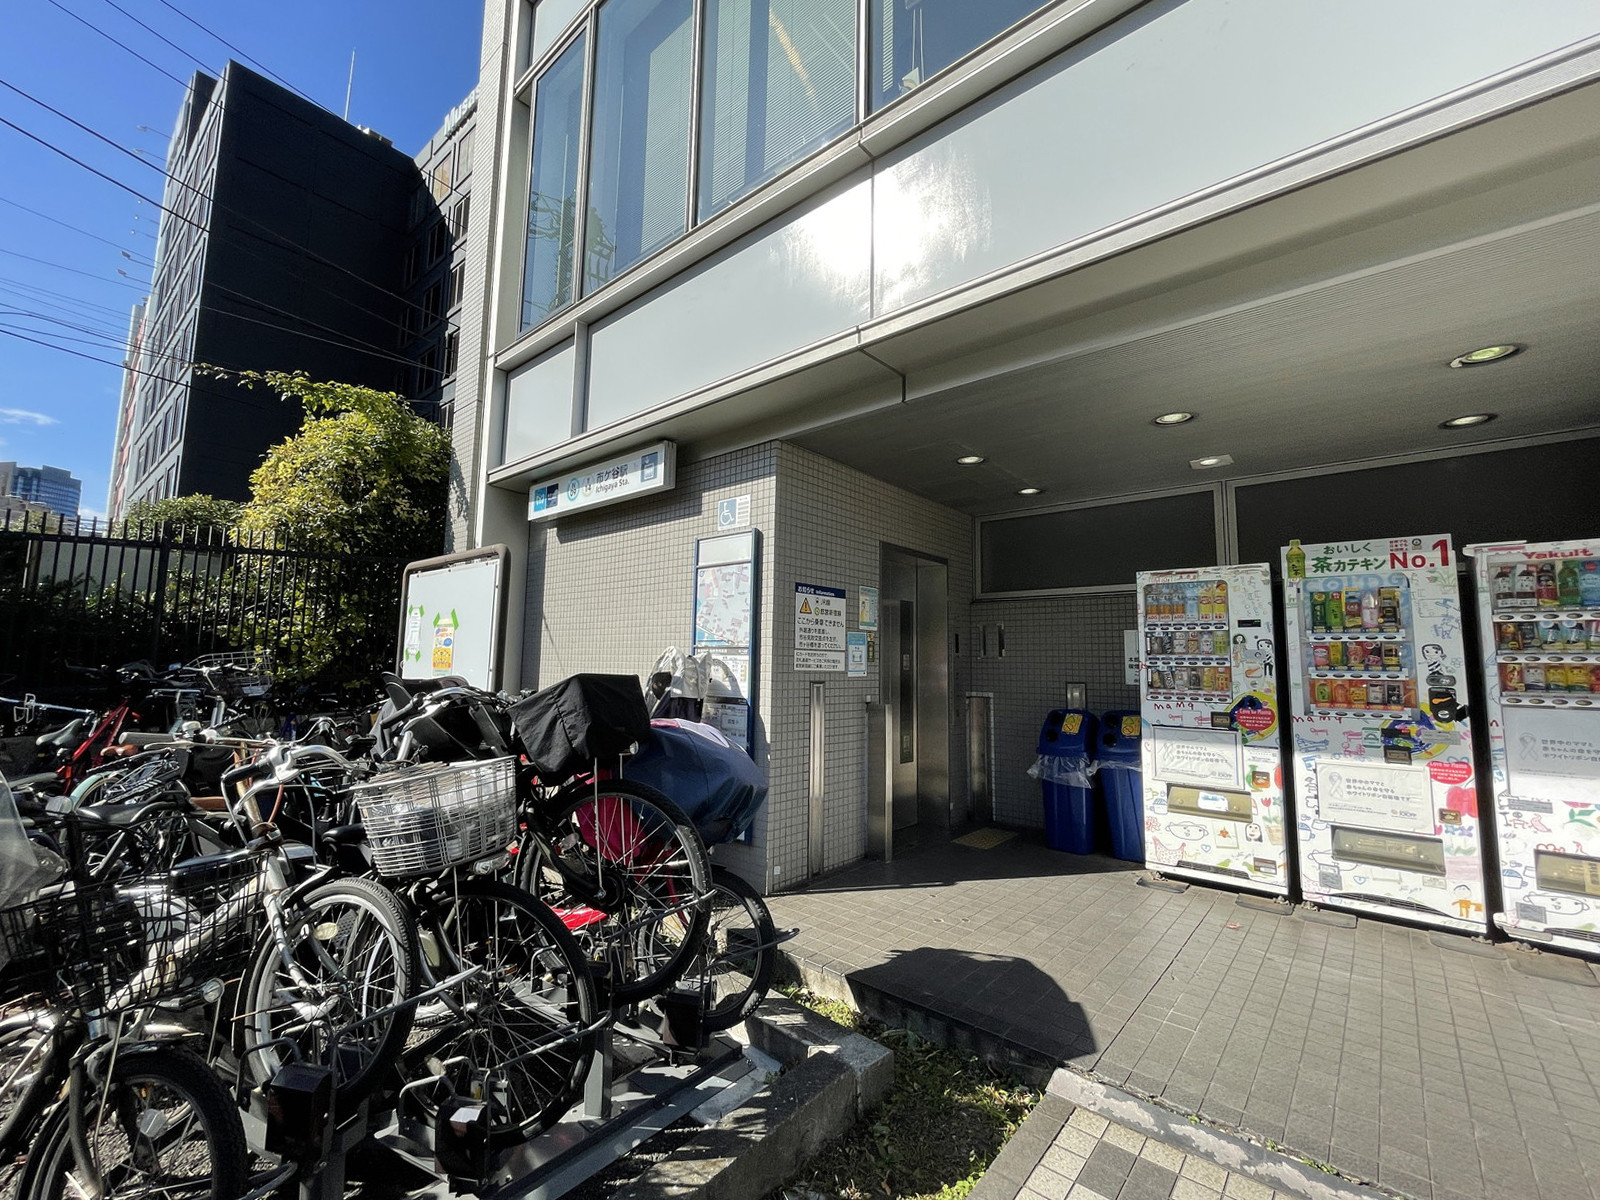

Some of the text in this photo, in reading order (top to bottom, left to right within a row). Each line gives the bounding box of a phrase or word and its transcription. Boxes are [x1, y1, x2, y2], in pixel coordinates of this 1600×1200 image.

[596, 482, 617, 493] Ichigaya
[1323, 542, 1372, 554] おいしく
[1522, 548, 1593, 559] Yakult
[1390, 539, 1449, 569] No.1
[1312, 556, 1386, 574] 茶カテキン
[797, 618, 844, 627] ここから乗車できません
